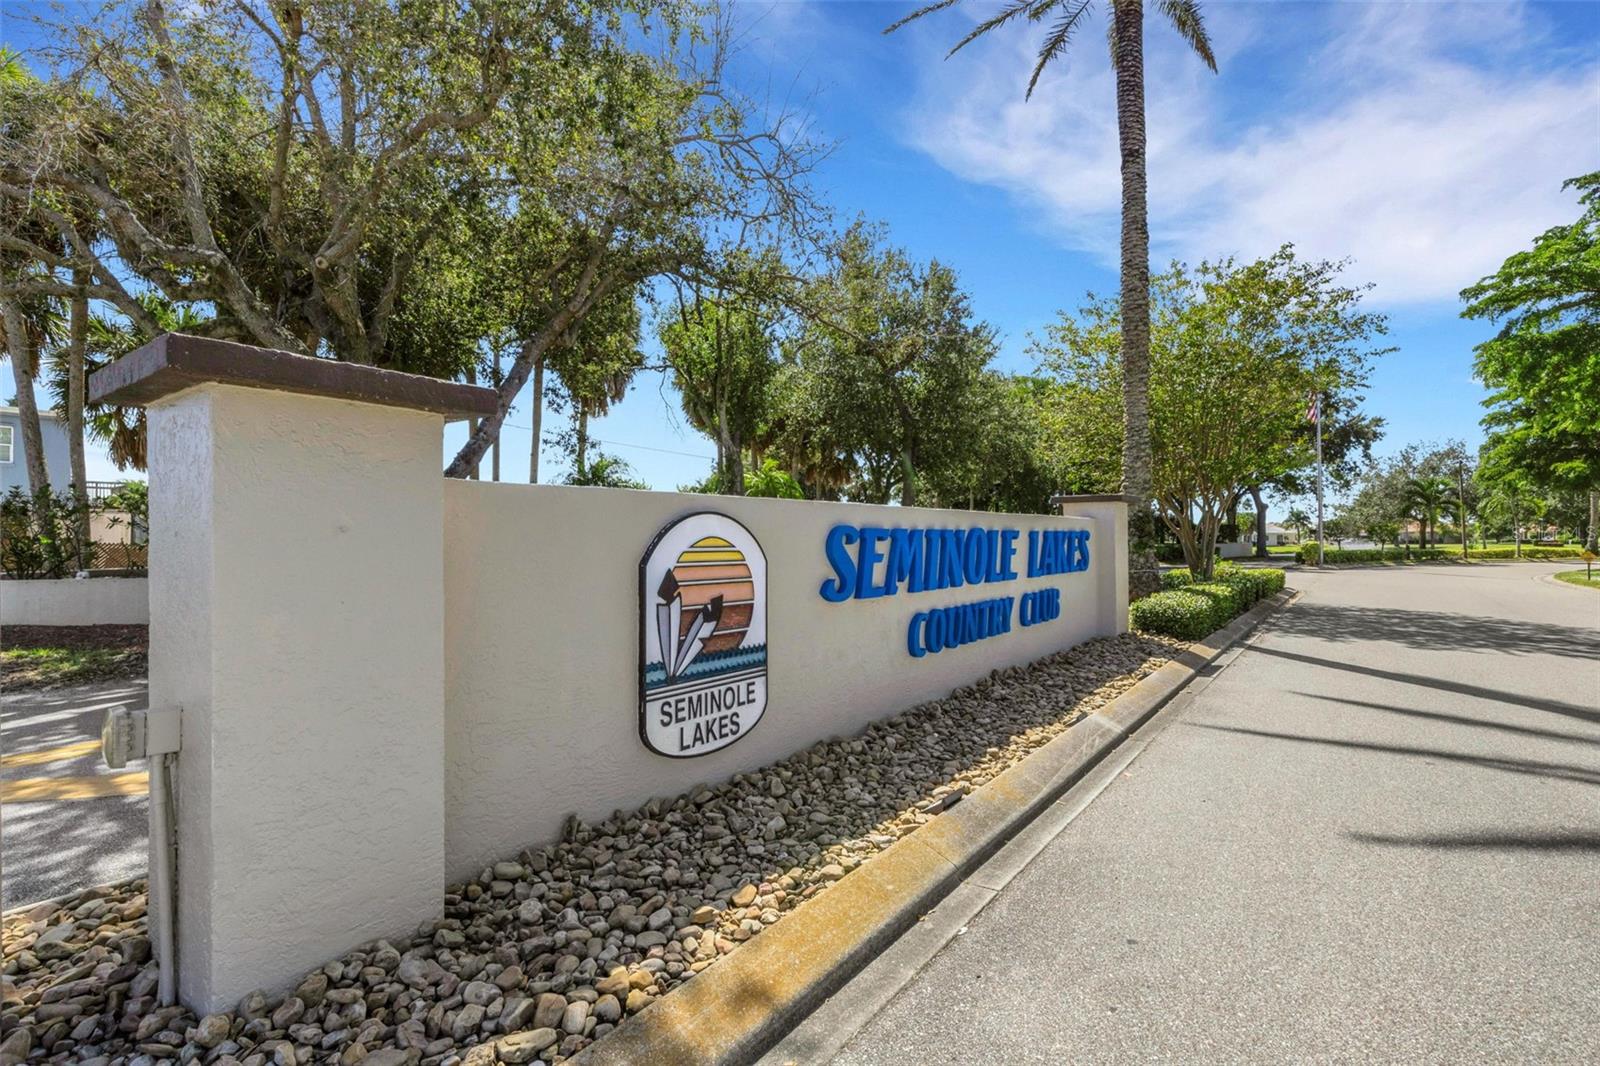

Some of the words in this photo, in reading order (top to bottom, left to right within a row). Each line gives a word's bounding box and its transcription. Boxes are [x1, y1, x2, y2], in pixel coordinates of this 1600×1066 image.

[820, 525, 1019, 602] SEMINOLE
[1028, 530, 1090, 578] LAKES
[908, 597, 1014, 658] COUNTRY
[1020, 588, 1060, 627] CLUB
[660, 682, 756, 727] SEMINOLE
[680, 712, 740, 751] LAKES
